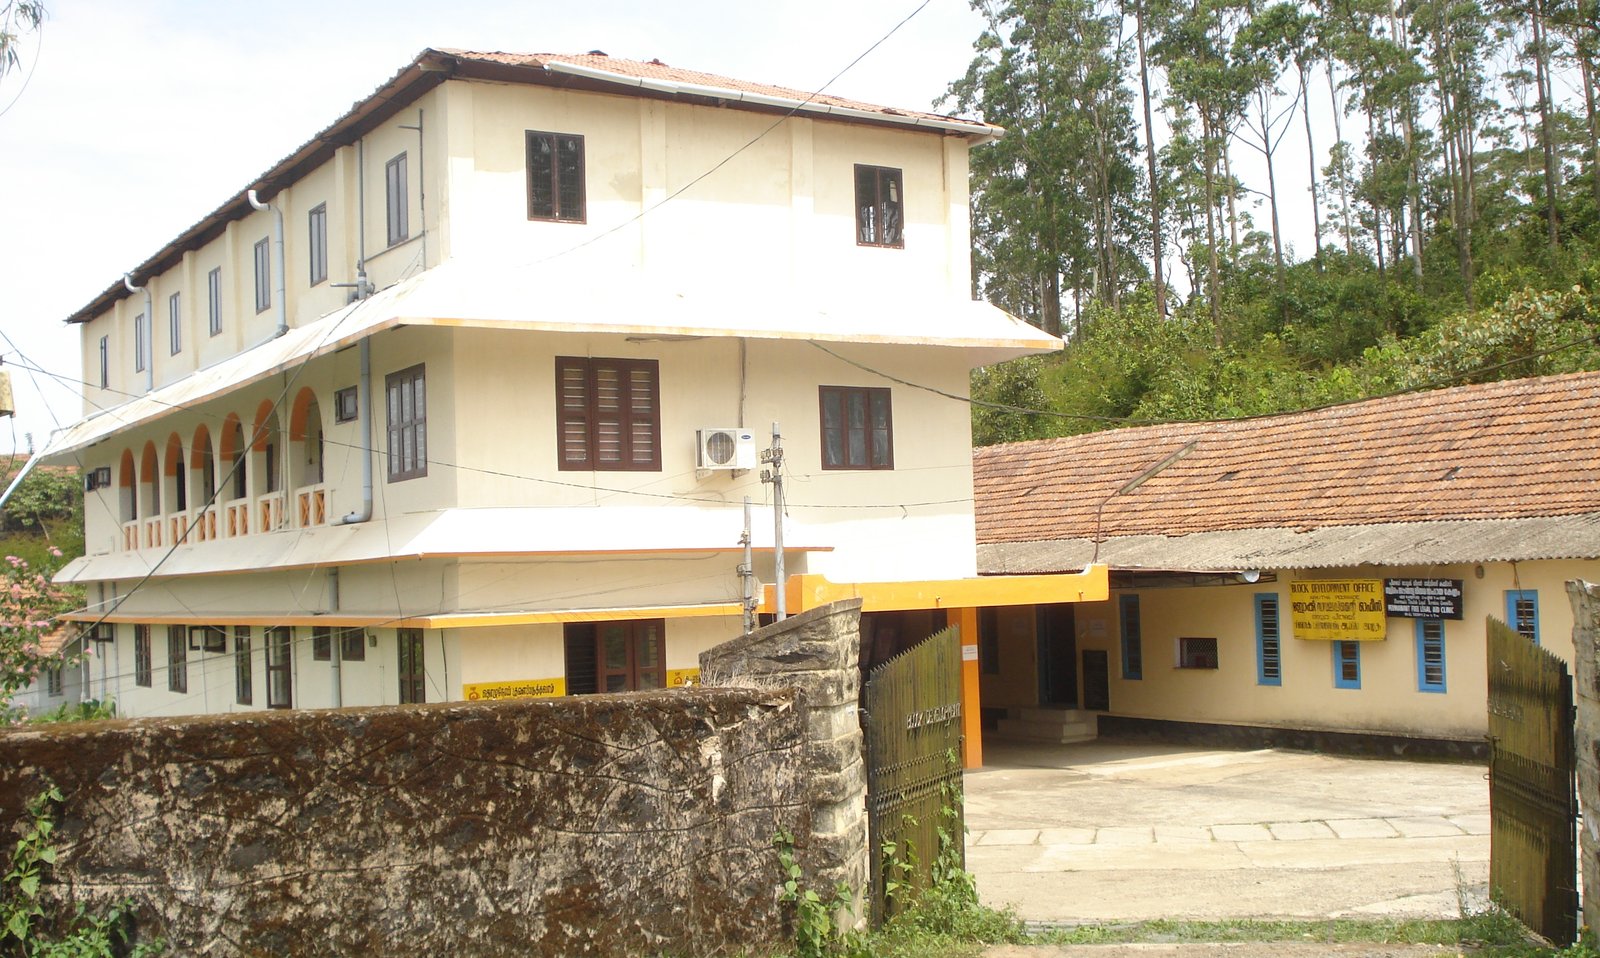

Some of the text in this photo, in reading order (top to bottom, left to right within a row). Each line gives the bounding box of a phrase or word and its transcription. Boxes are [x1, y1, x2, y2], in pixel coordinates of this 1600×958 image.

[1291, 584, 1309, 593] BLOCK
[1312, 583, 1350, 592] DEVELOPMENT
[1354, 582, 1374, 592] OFFICE
